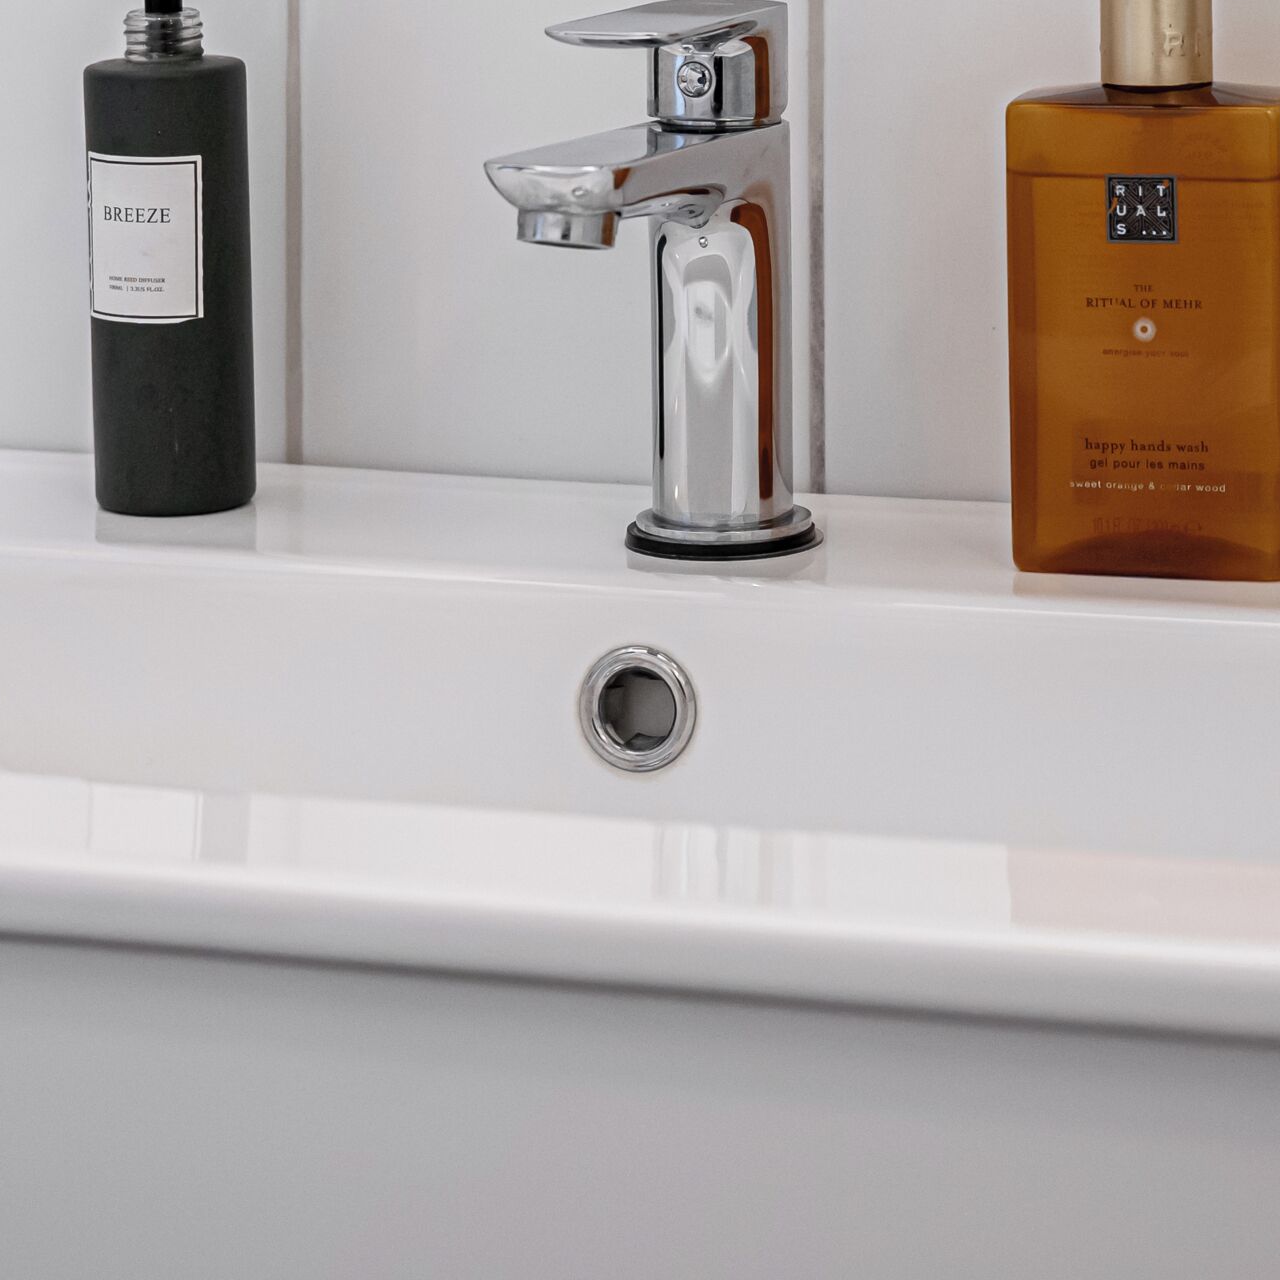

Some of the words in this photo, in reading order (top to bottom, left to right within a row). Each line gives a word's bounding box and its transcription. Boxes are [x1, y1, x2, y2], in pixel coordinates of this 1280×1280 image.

[103, 205, 171, 224] BREEZE
[1134, 284, 1152, 293] THE
[1140, 298, 1158, 309] OF
[1163, 299, 1203, 310] MEHR
[1084, 438, 1126, 454] happy
[1131, 439, 1171, 452] hands
[1176, 441, 1209, 453] wash
[1090, 458, 1108, 470] gel
[1113, 460, 1141, 470] pour
[1146, 459, 1164, 470] les
[1168, 460, 1206, 470] mains
[1070, 480, 1102, 489] sweet
[1148, 481, 1156, 490] &
[1195, 483, 1226, 493] wood
